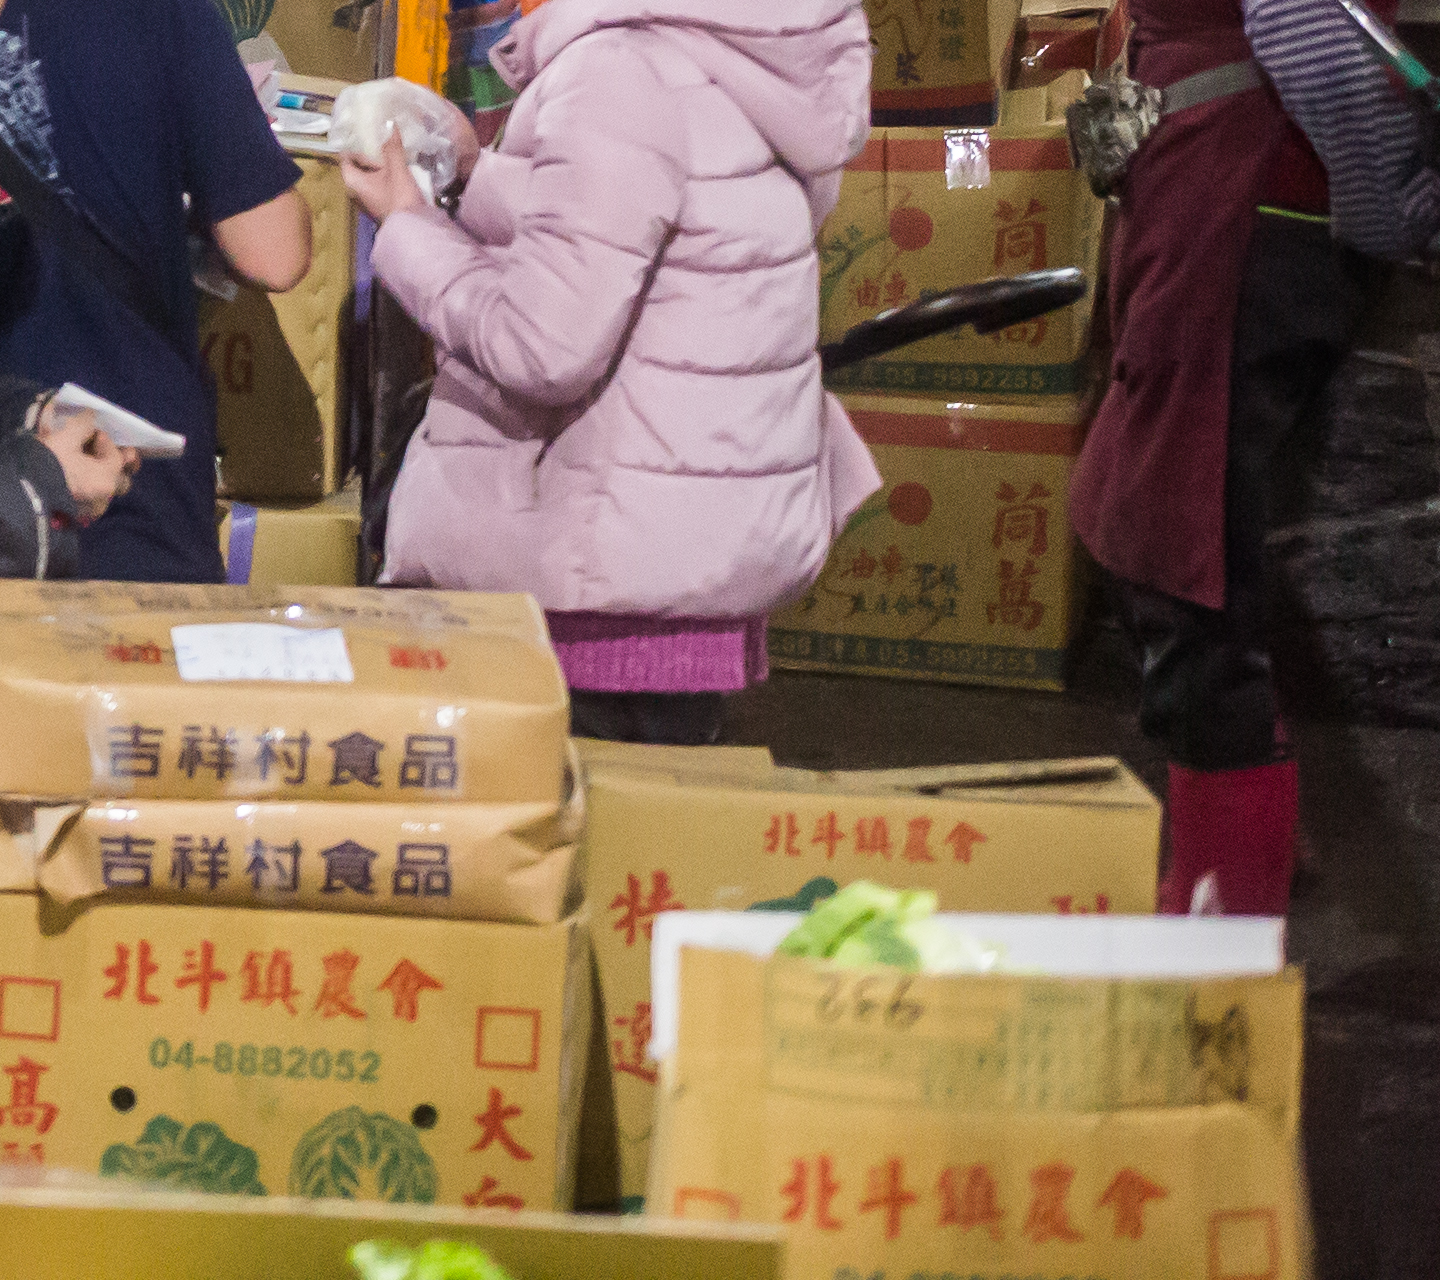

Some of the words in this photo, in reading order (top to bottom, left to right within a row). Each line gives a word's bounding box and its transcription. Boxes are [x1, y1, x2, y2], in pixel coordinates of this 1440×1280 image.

[107, 722, 460, 791] 吉祥村食品
[99, 834, 452, 899] 吉祥村食品
[764, 810, 989, 866] 北斗鎮農會
[103, 940, 445, 1022] 北斗鎮農會
[149, 1037, 382, 1085] 04-8882052
[781, 1151, 1170, 1243] 北斗鎮農會
